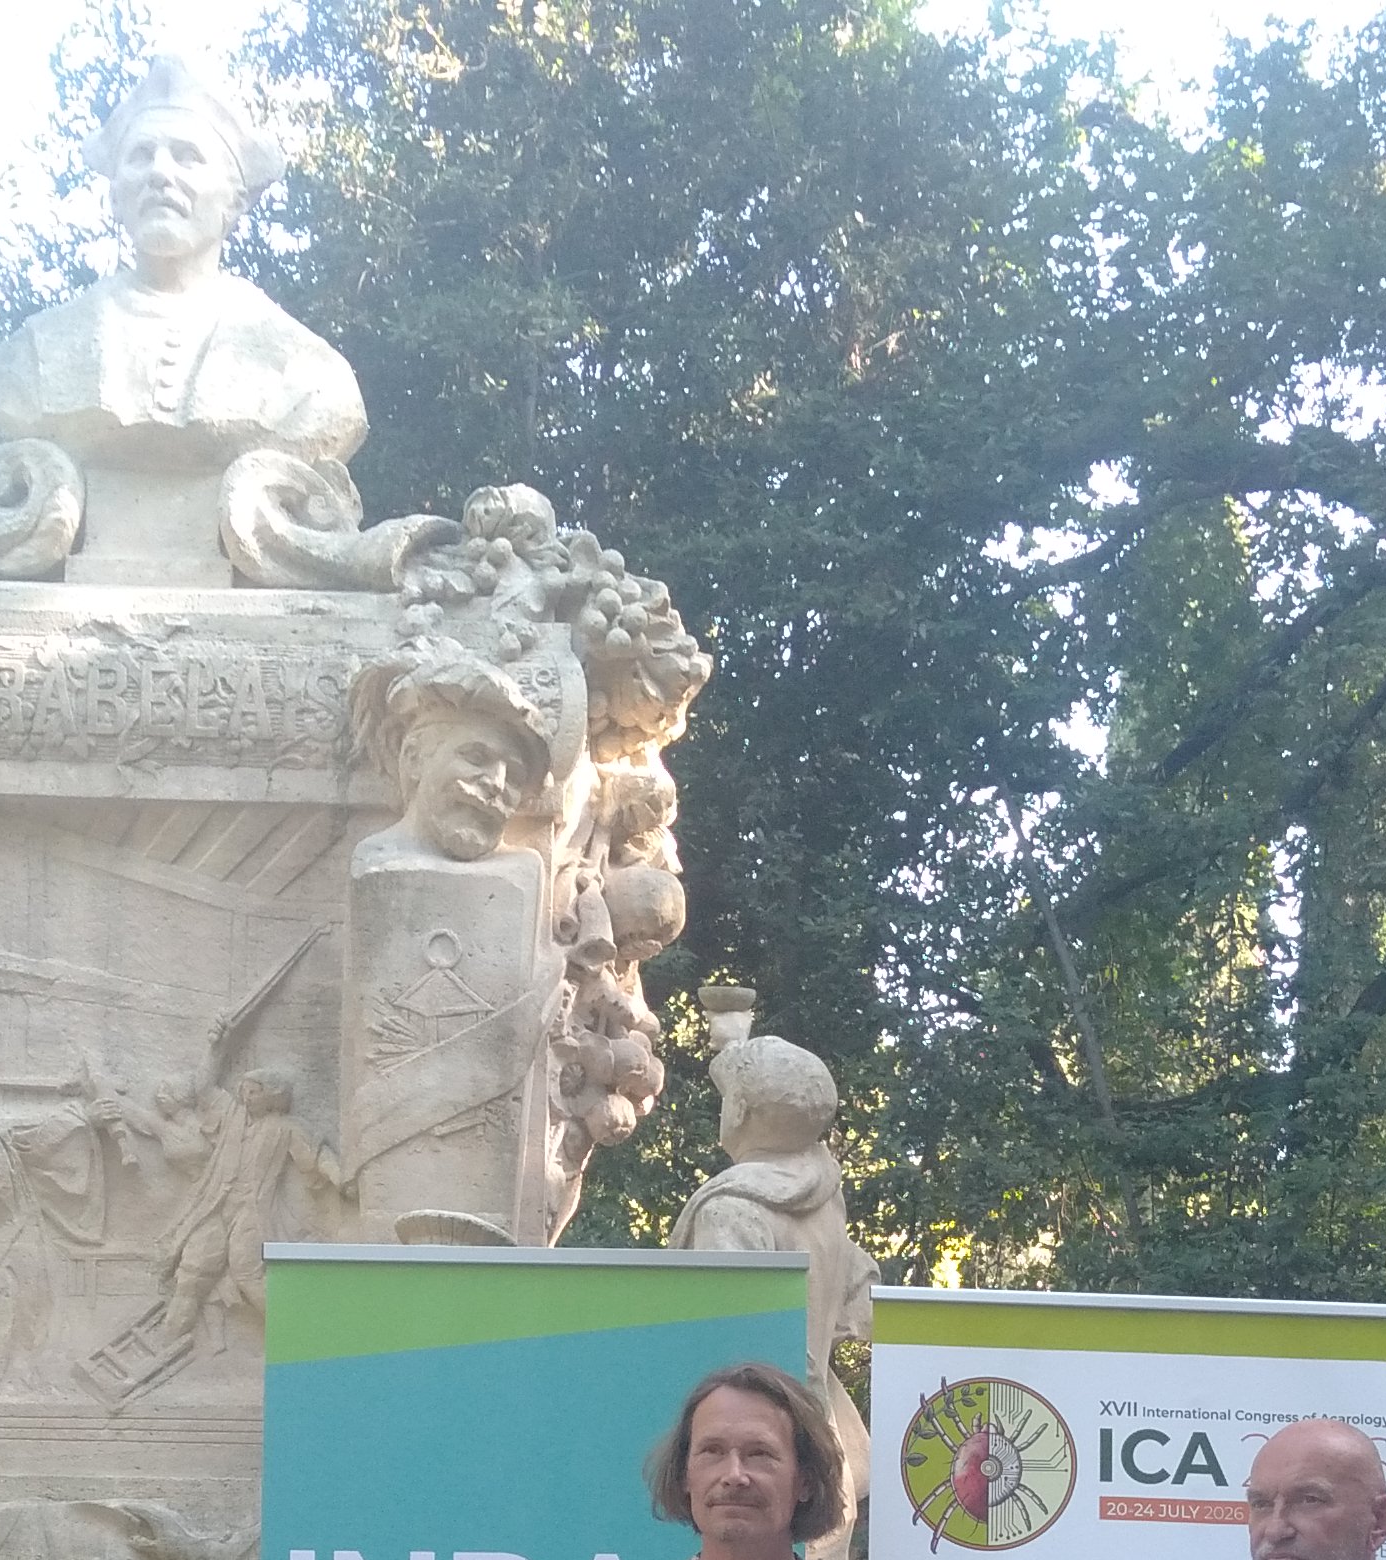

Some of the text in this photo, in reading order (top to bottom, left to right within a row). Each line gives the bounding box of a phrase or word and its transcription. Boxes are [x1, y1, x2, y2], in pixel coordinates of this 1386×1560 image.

[1099, 1400, 1138, 1417] XVII
[1142, 1406, 1231, 1421] International
[1234, 1409, 1299, 1423] Congress
[1099, 1428, 1229, 1487] ICA
[1106, 1502, 1245, 1521] 20-24 JULY 2026
